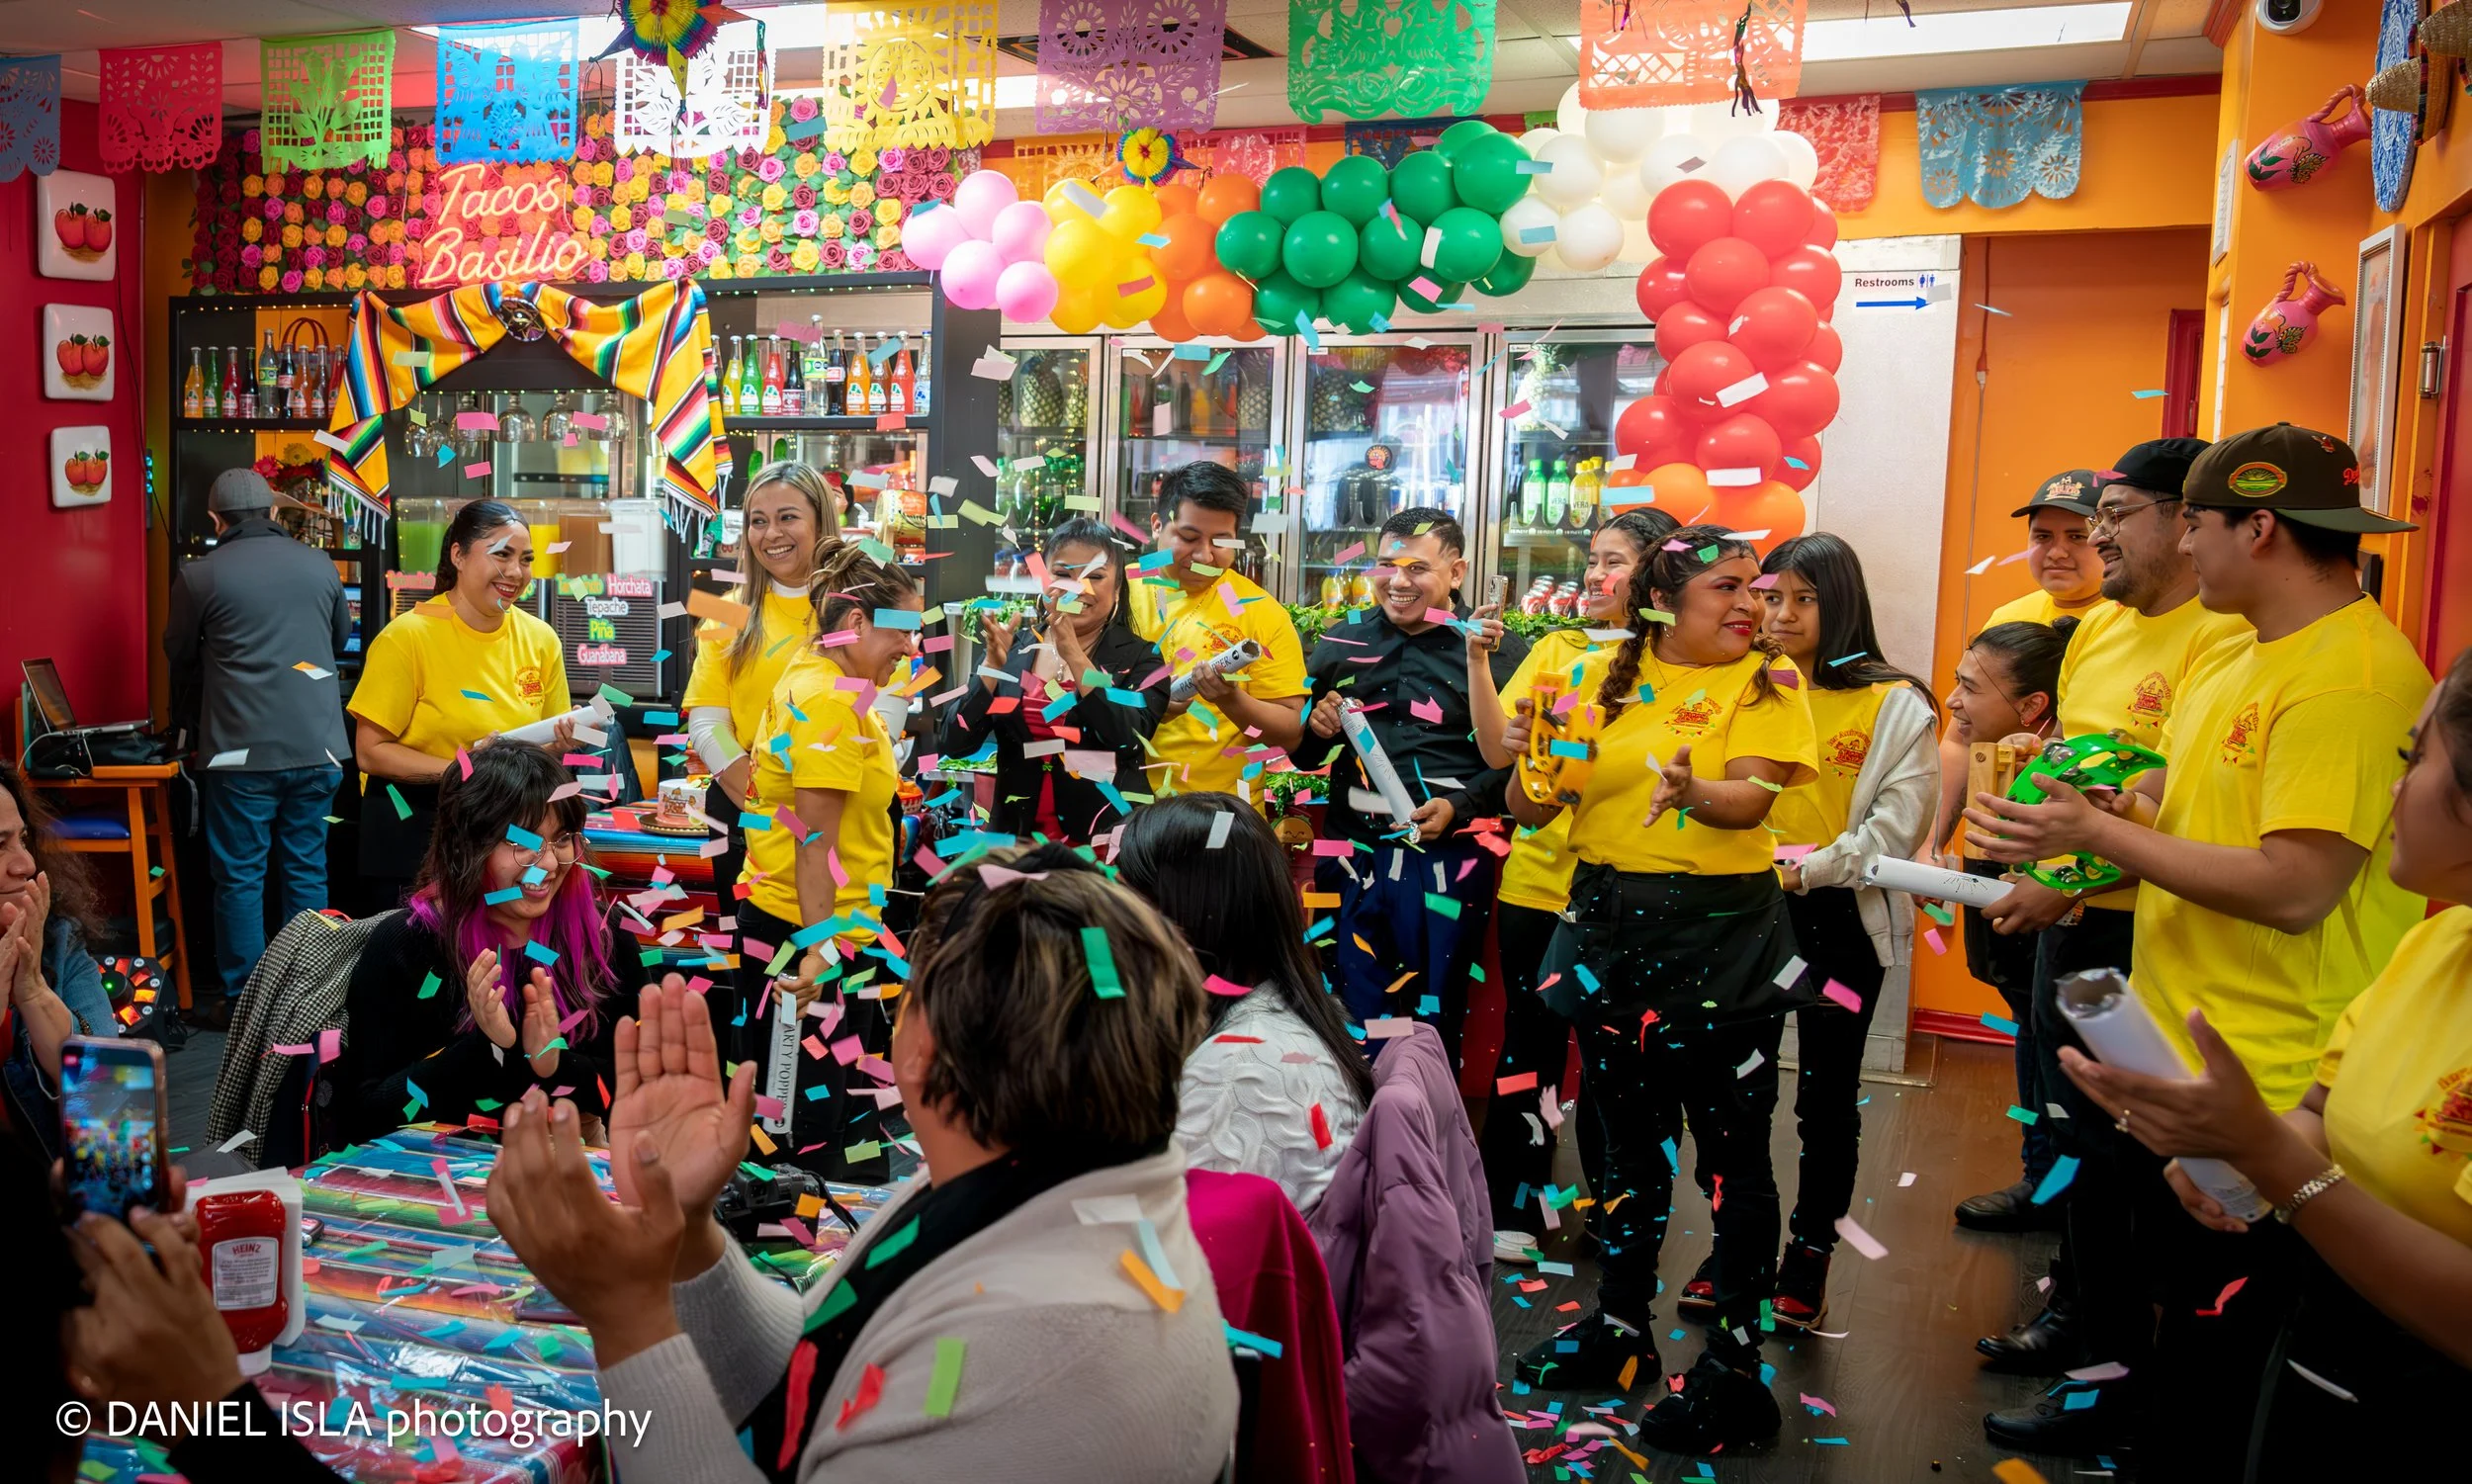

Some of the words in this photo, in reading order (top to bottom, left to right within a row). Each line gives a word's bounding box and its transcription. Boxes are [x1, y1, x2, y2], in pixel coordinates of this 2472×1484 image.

[438, 163, 562, 225] Tacos
[419, 220, 589, 285] Basilio
[1855, 278, 1914, 287] Restrooms
[608, 573, 652, 593] Horchata
[587, 597, 627, 616] Tepache
[590, 620, 614, 640] Piña
[781, 1024, 795, 1060] ARTY
[776, 1063, 792, 1109] POPPE
[231, 1243, 262, 1256] HEINZ
